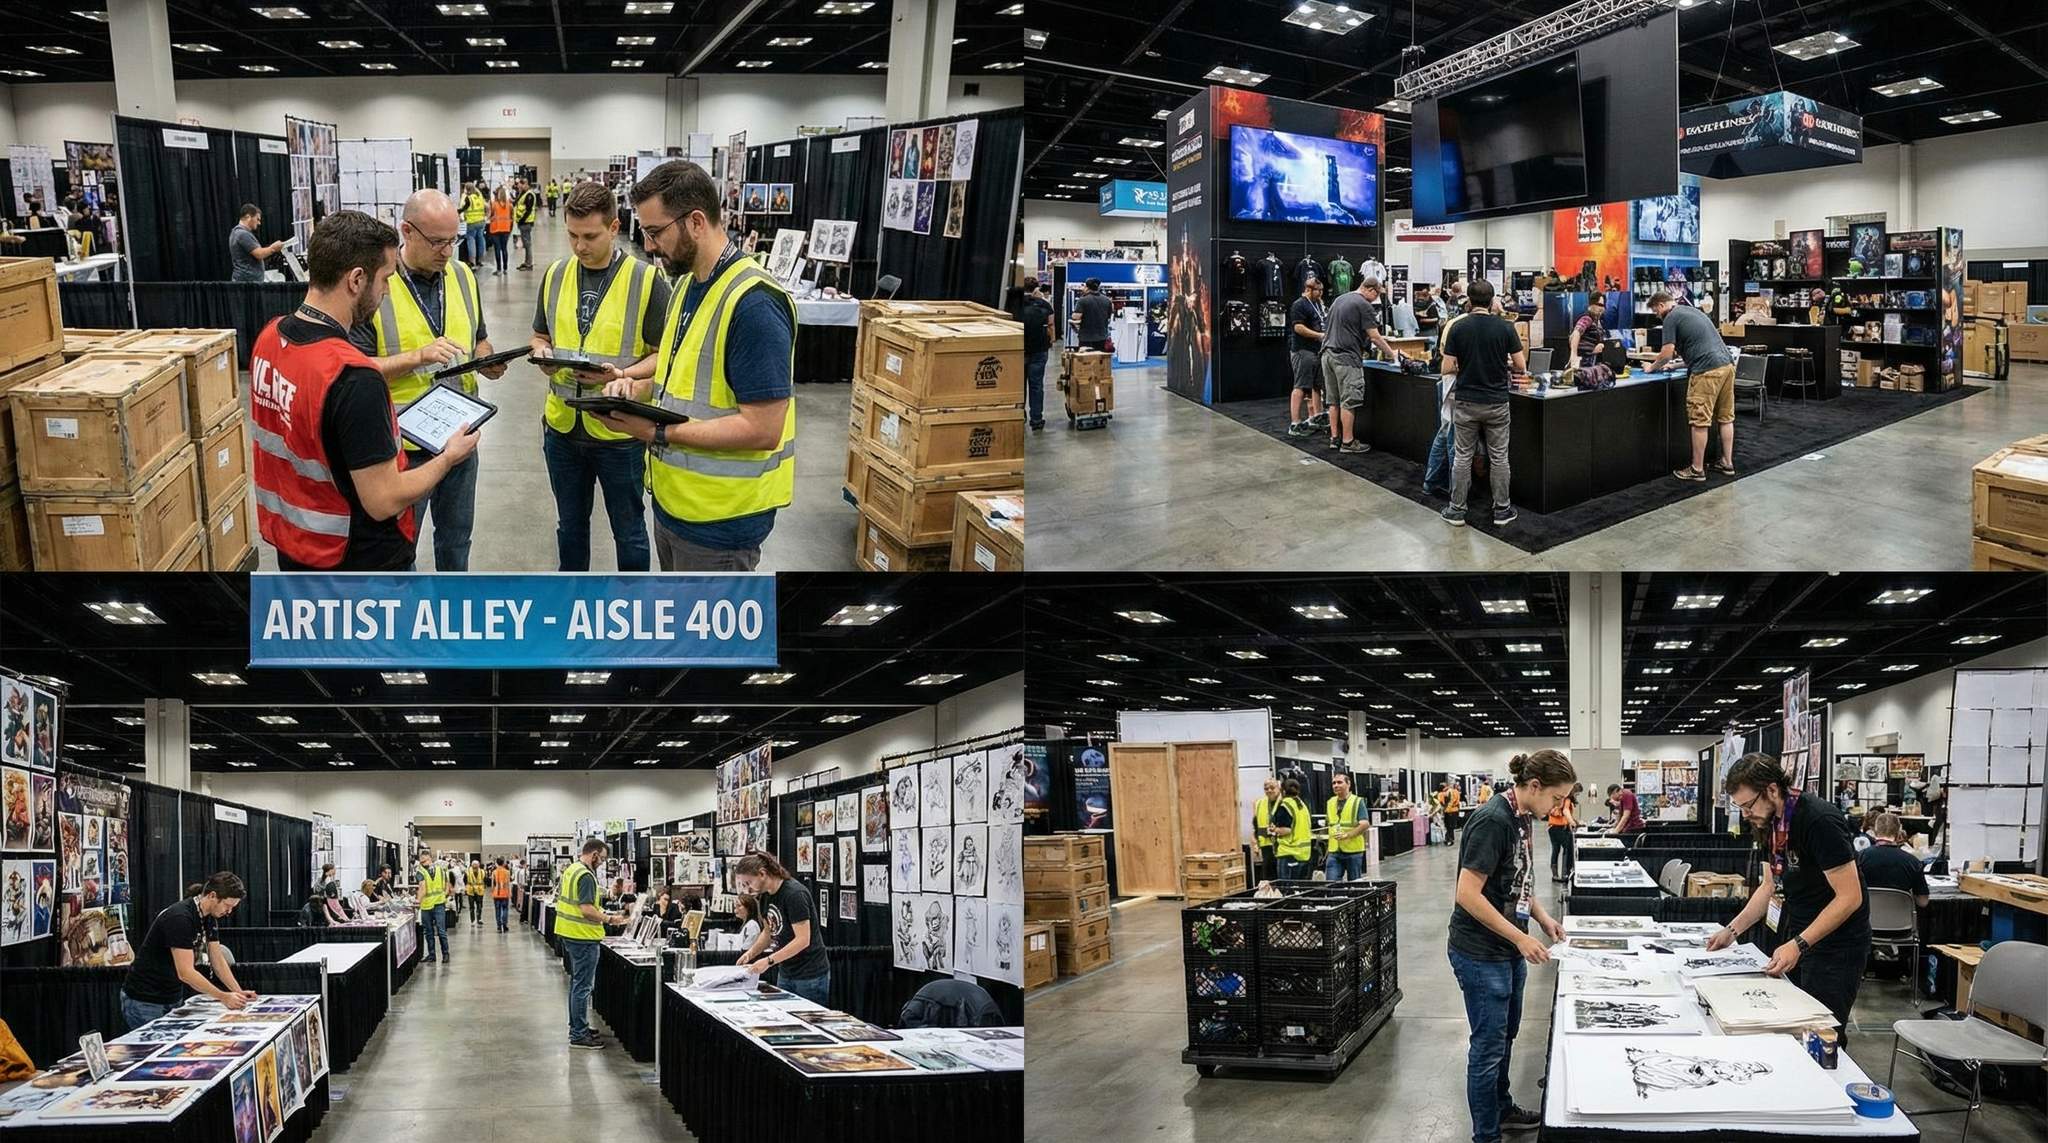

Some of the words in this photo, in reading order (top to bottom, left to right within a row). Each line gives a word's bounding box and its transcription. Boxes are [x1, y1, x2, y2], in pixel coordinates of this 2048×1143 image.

[262, 599, 401, 640] ARTIST
[411, 599, 533, 640] ALLEY
[566, 599, 676, 640] AISLE
[685, 599, 763, 640] 400
